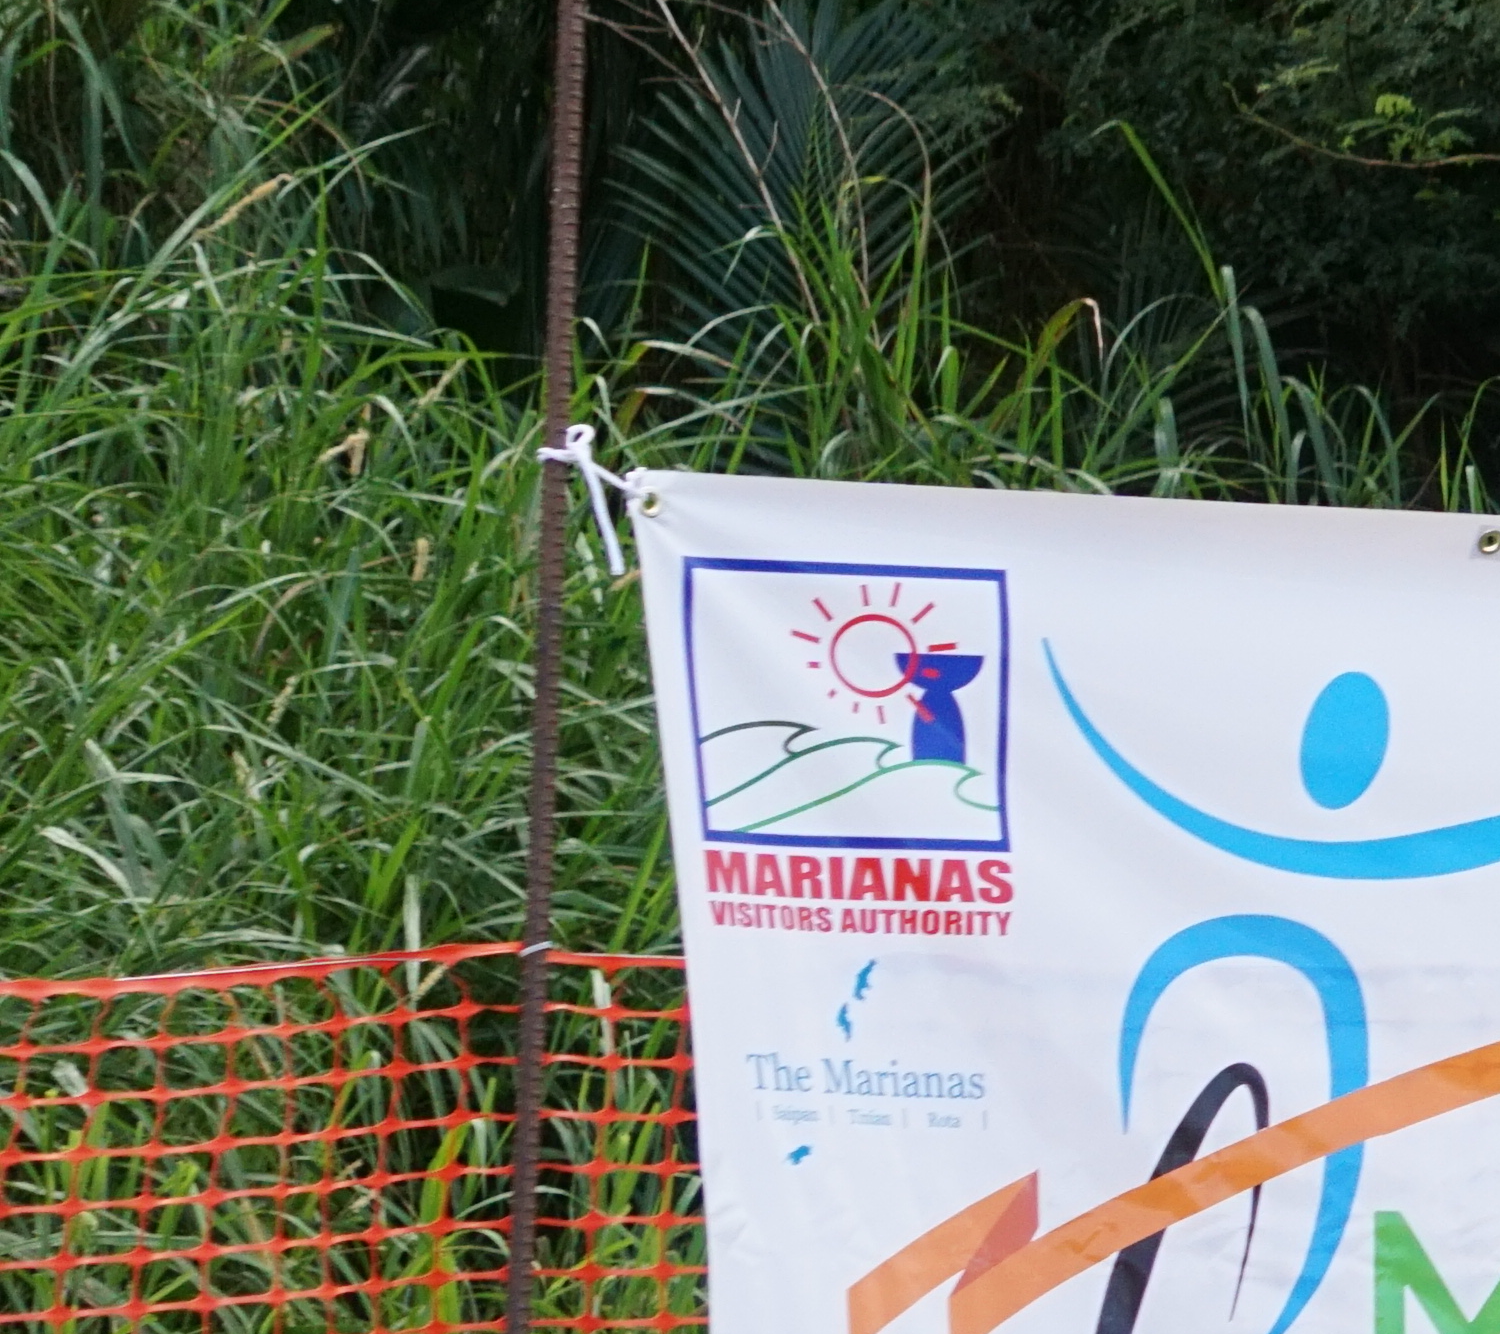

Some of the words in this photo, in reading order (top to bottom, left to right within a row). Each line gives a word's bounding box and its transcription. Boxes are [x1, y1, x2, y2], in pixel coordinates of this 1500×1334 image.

[704, 849, 1014, 904] MARIANAS
[709, 900, 833, 933] VISITORS
[840, 907, 1013, 937] AUTHORITY
[746, 1052, 812, 1093] The
[821, 1057, 986, 1100] Marianas
